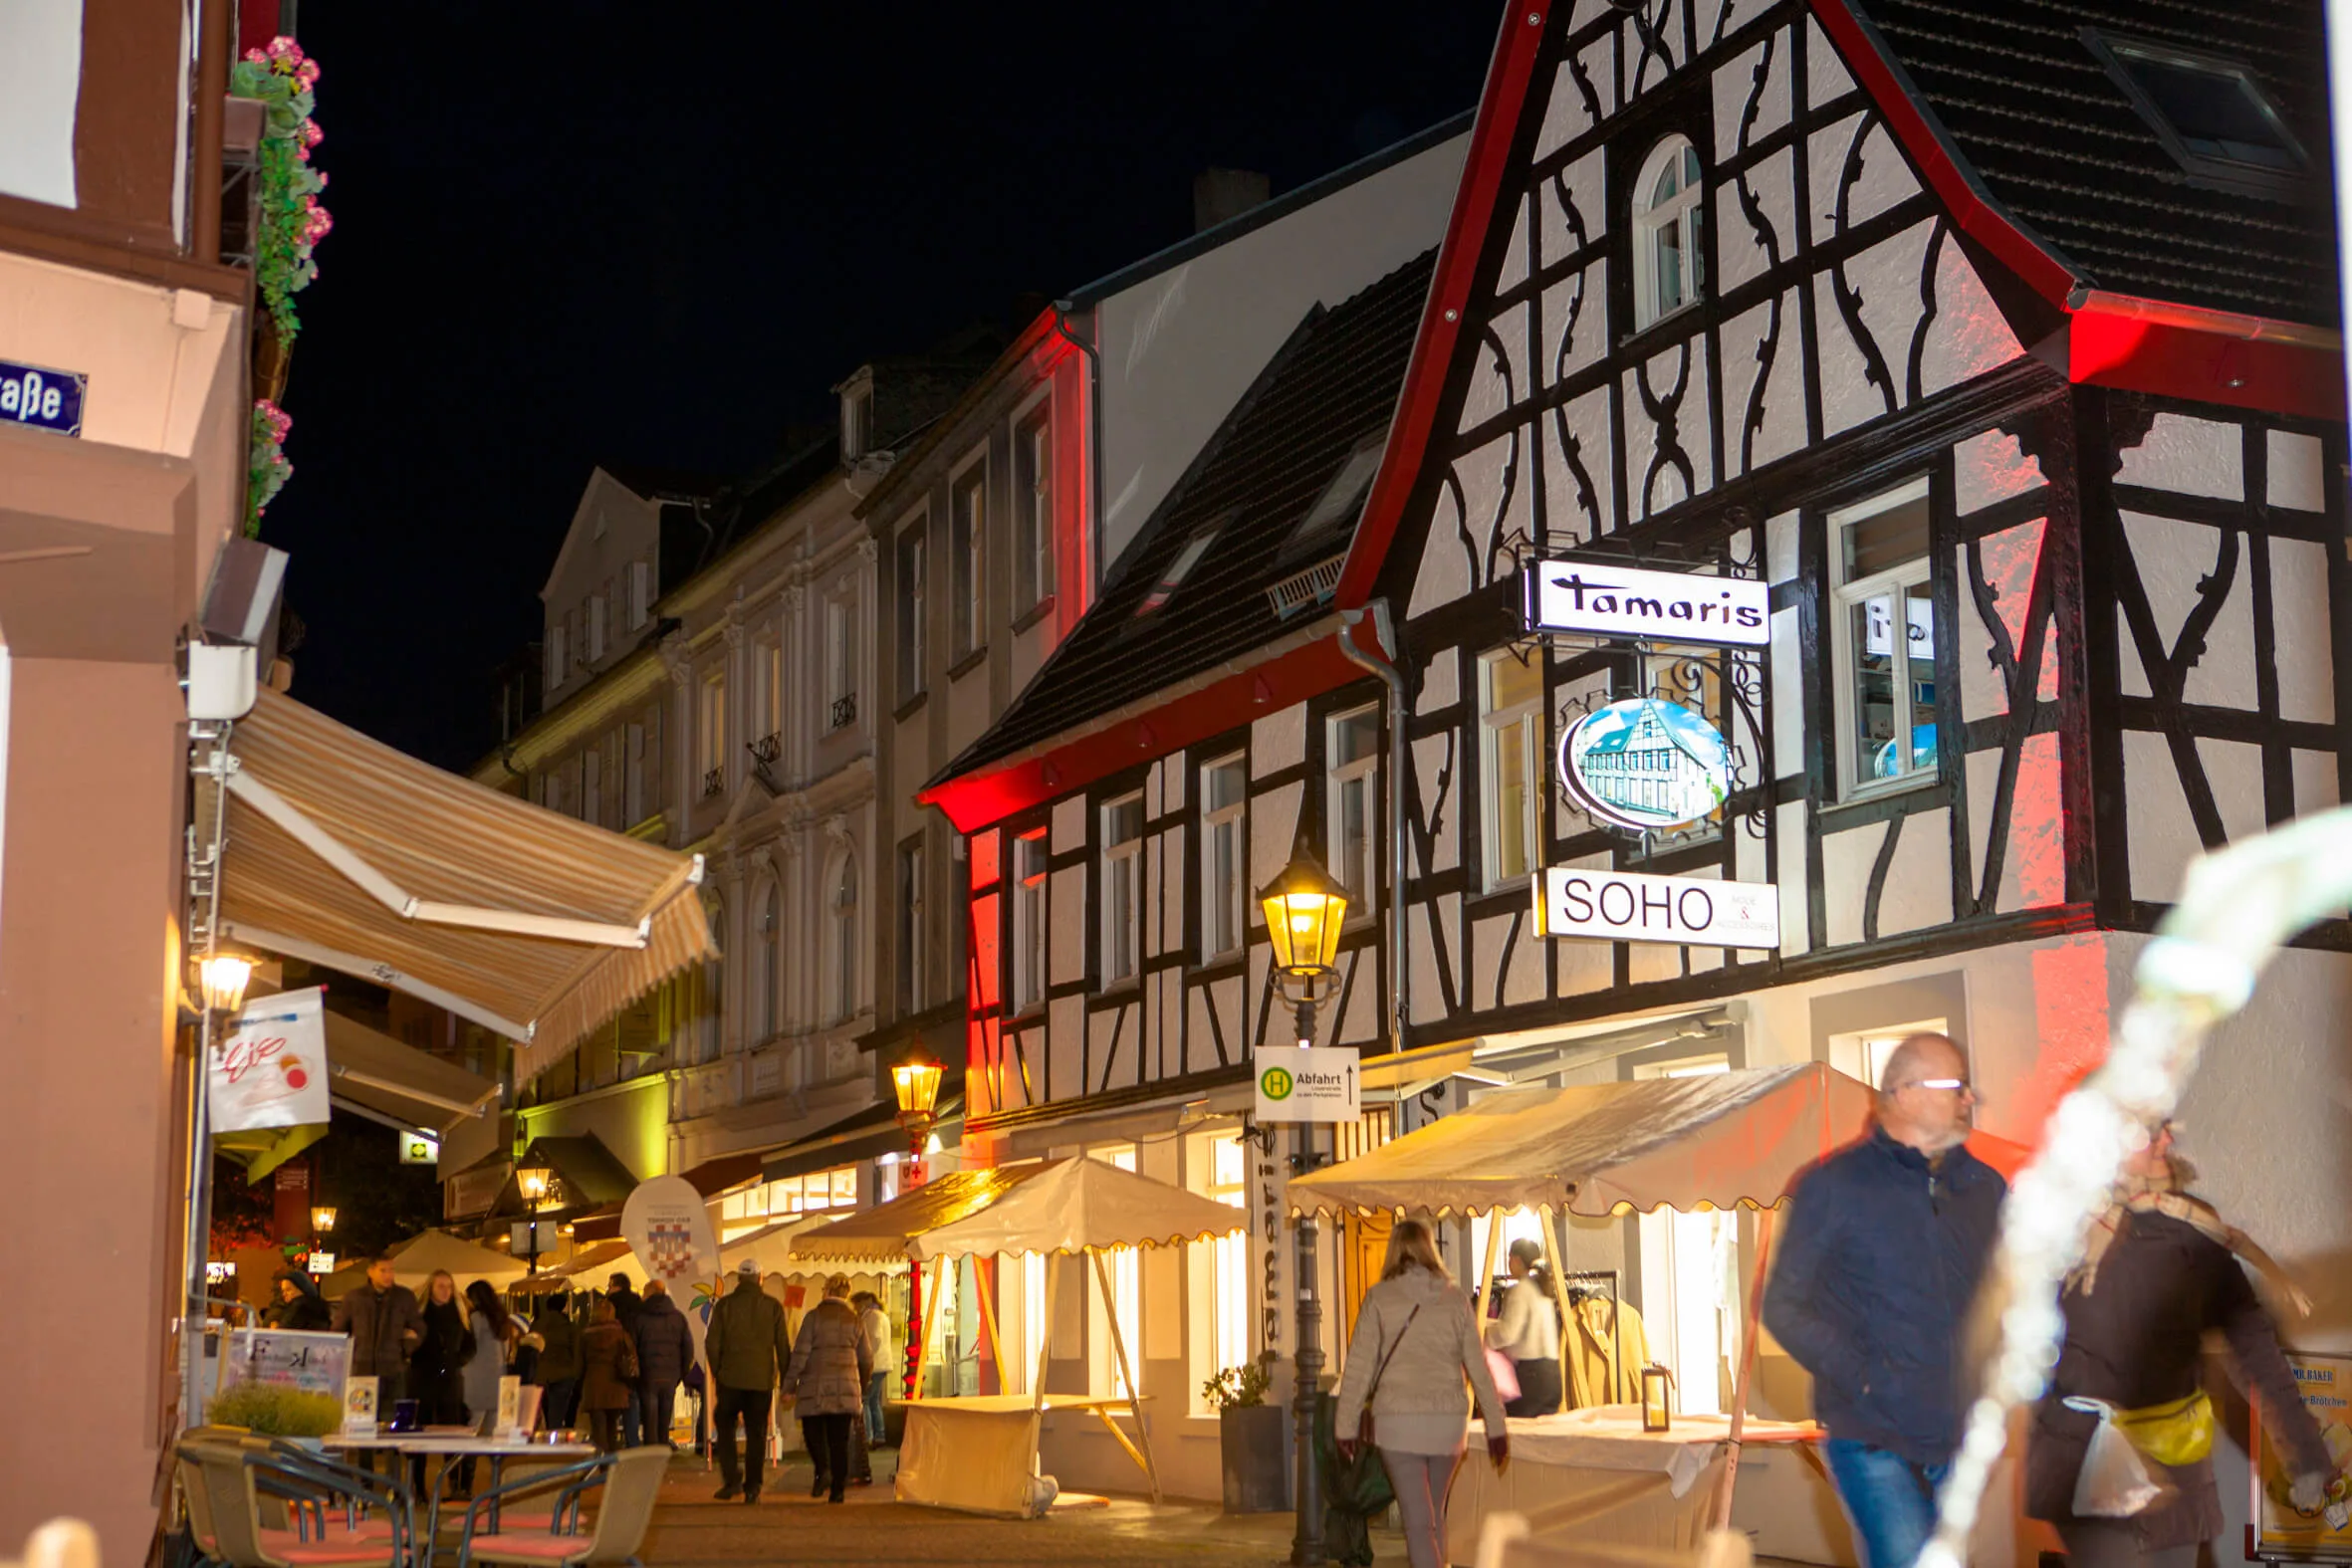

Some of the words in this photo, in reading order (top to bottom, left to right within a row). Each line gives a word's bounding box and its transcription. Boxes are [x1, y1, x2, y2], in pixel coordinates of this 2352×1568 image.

[0, 370, 62, 421] aße
[1550, 573, 1763, 627] tamaris
[1563, 878, 1713, 931] SOHO
[1296, 1072, 1341, 1084] Abfahrt
[2307, 1369, 2333, 1381] BAKER
